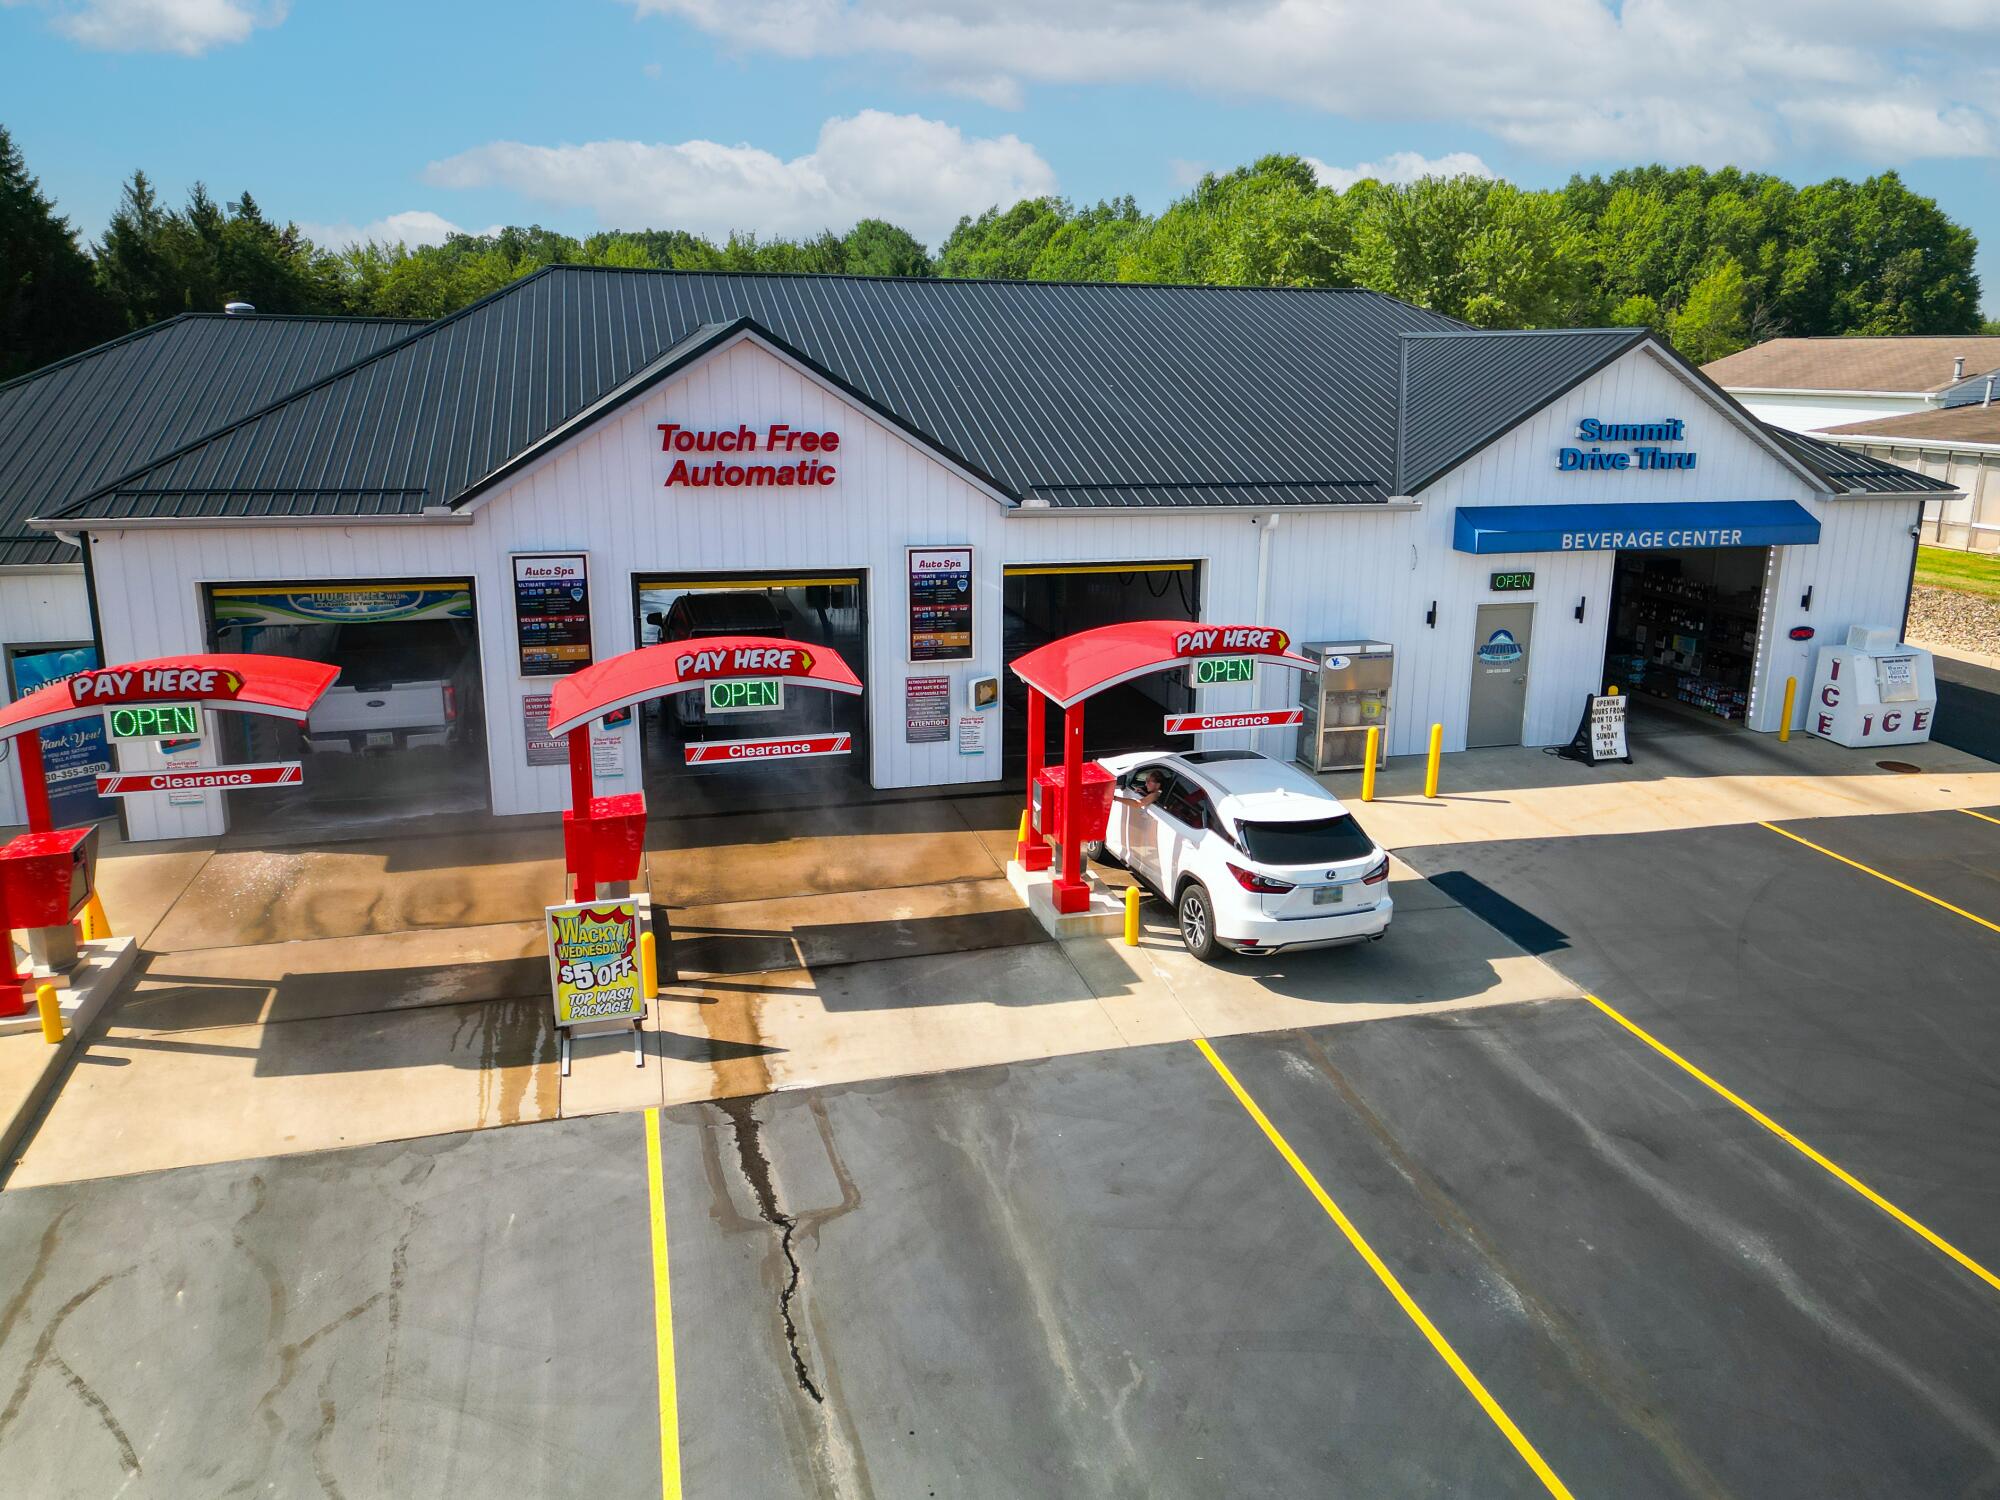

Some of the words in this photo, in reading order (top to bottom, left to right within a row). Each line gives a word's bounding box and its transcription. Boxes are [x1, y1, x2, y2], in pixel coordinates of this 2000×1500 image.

[657, 424, 757, 452] Touch
[766, 424, 840, 452] Free
[1579, 418, 1685, 442] Summit
[1559, 447, 1631, 471] Drive
[1633, 447, 1697, 470] Thru
[664, 459, 837, 487] Automatic
[1562, 531, 1664, 549] BEVERAGE
[1668, 530, 1743, 547] CENTER
[525, 567, 552, 576] Auto
[553, 566, 575, 578] Spa
[919, 560, 942, 569] Auto
[943, 559, 962, 570] Spa
[1496, 574, 1532, 588] OPEN
[1177, 630, 1218, 652] PAY
[1223, 629, 1274, 648] HERE
[677, 650, 727, 676] PAY
[733, 648, 796, 669] HERE
[1198, 659, 1252, 682] OPEN
[73, 671, 133, 700] PAY
[143, 670, 218, 692] HERE
[712, 681, 777, 707] OPEN
[114, 706, 195, 736] OPEN
[1201, 716, 1270, 729] Clearance
[1863, 707, 1931, 736] ICE
[1596, 732, 1618, 740] SUNDAY
[729, 743, 811, 758] Clearance
[45, 763, 107, 781] 30-355-9500
[150, 773, 252, 789] Clearance
[561, 962, 595, 989] $5
[597, 956, 633, 986] OFF
[569, 993, 594, 1006] TOP
[597, 988, 634, 1002] WASH
[570, 999, 633, 1018] PACKAGE!
